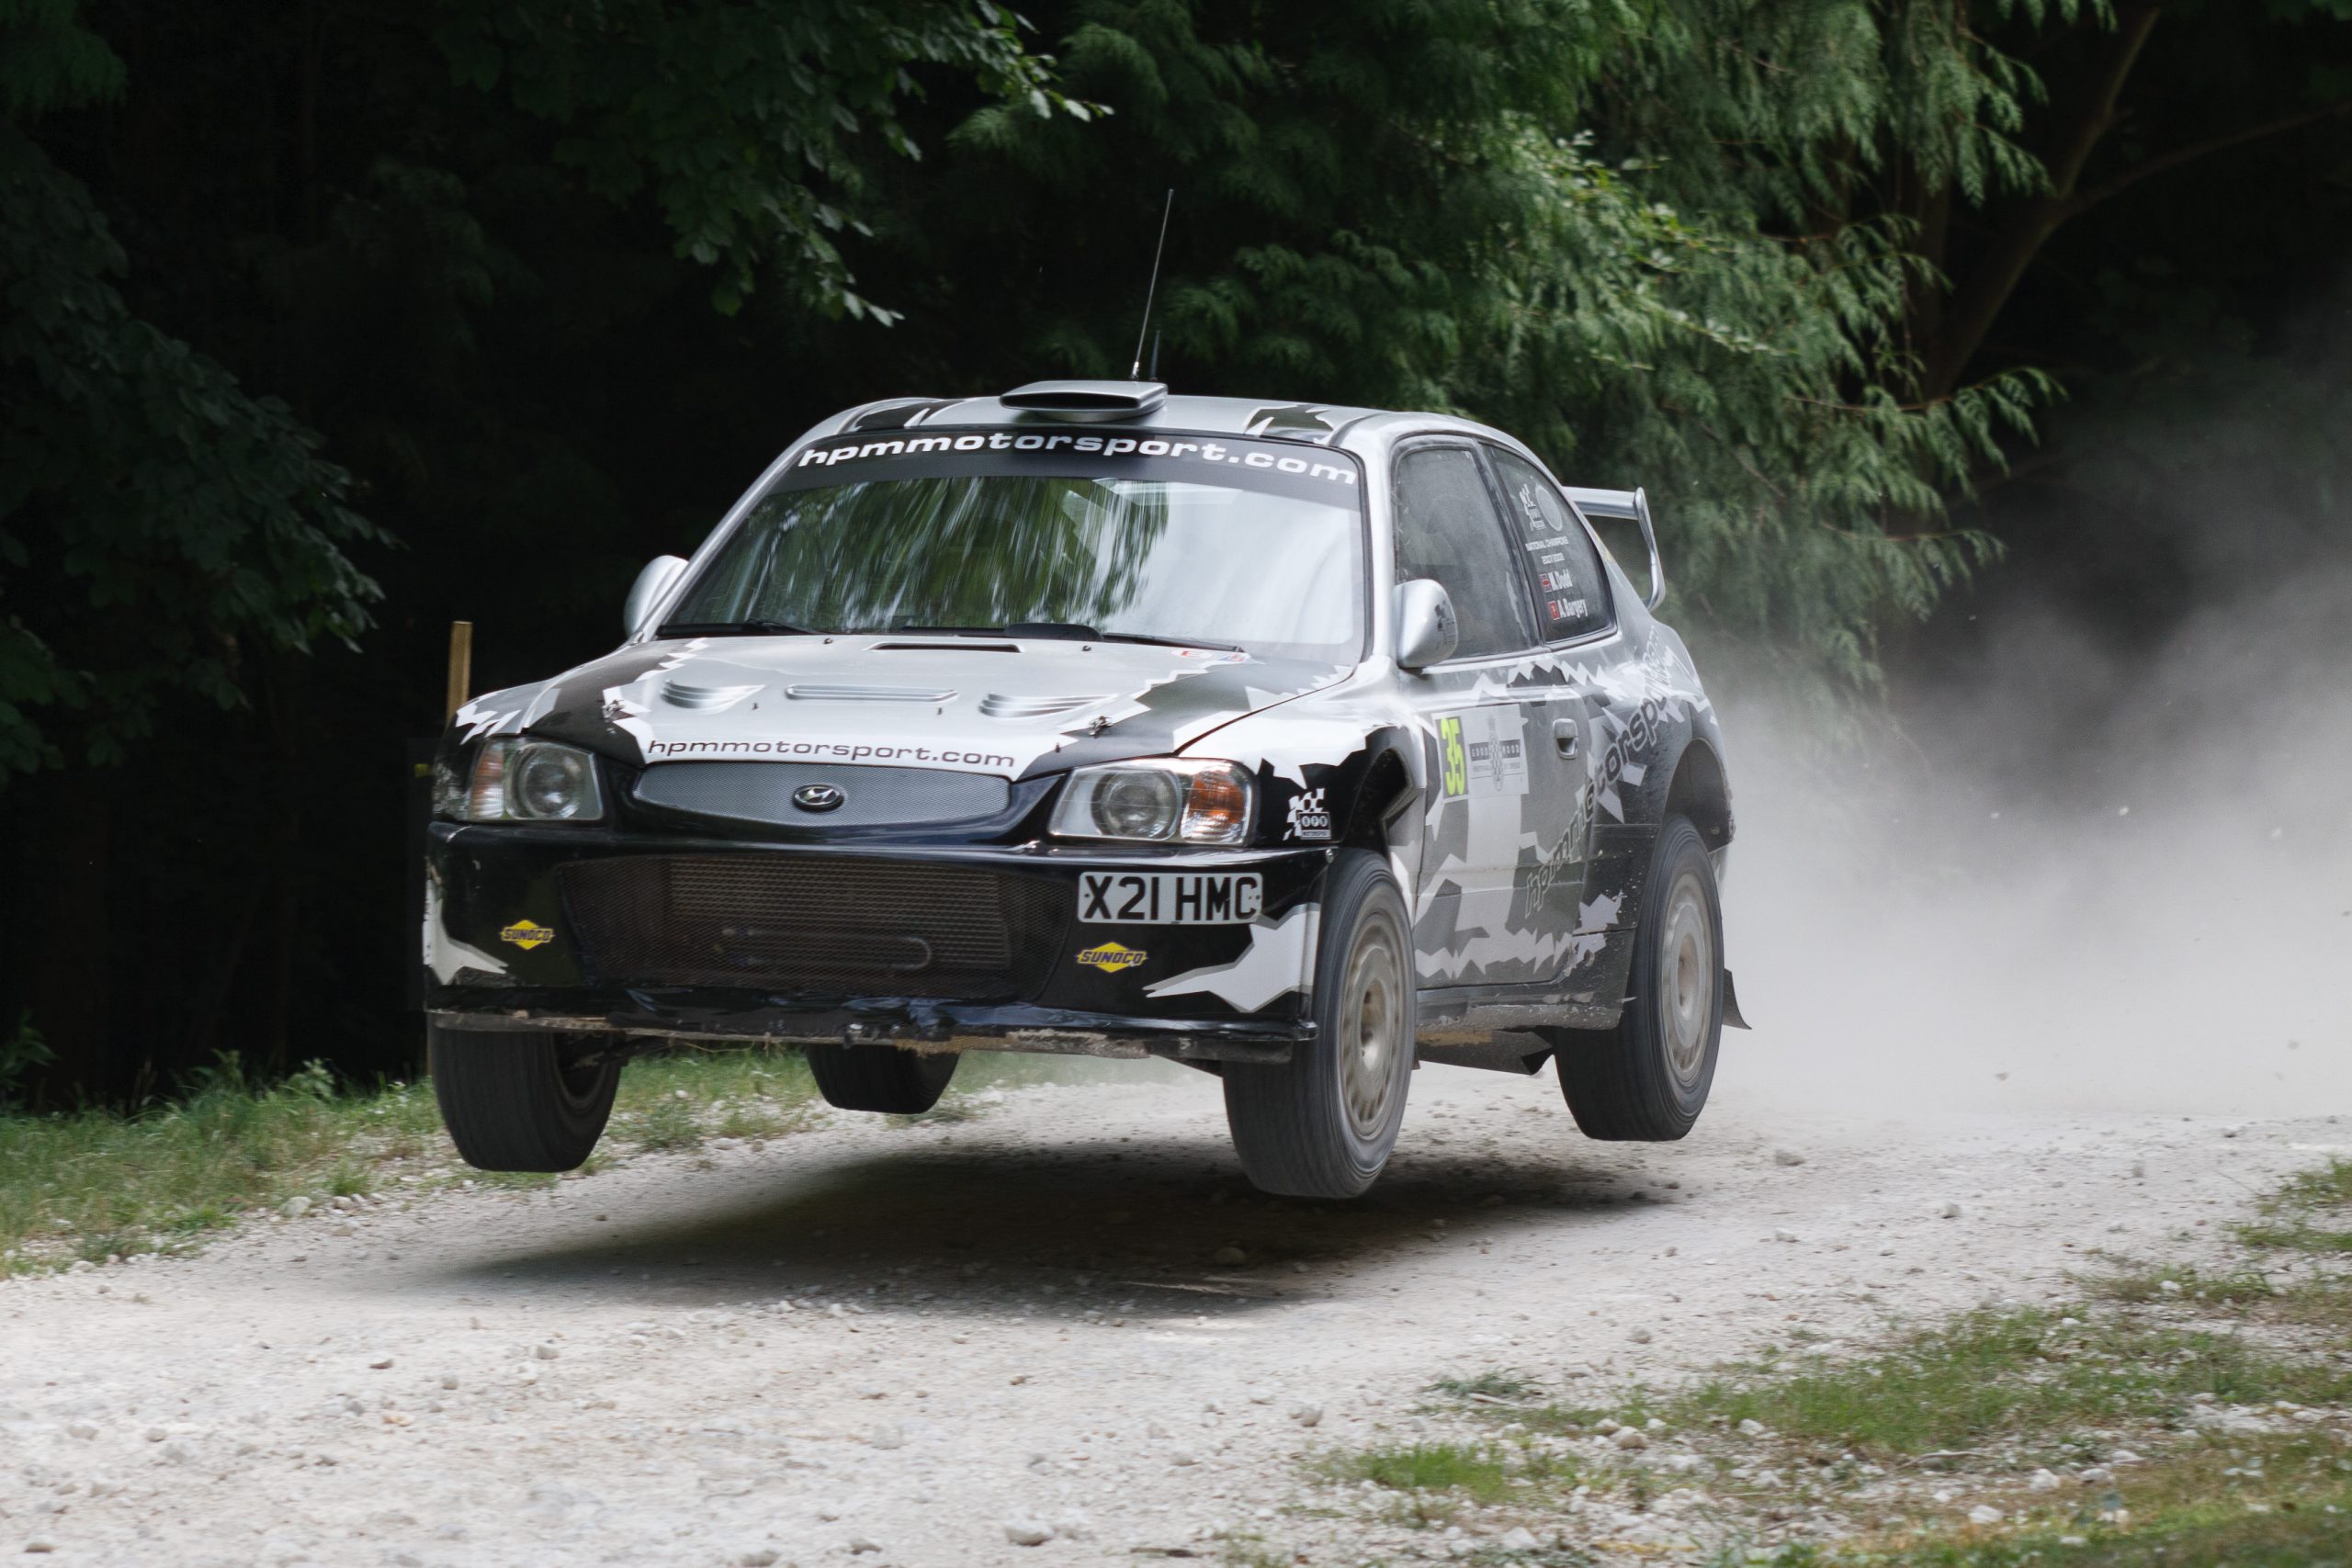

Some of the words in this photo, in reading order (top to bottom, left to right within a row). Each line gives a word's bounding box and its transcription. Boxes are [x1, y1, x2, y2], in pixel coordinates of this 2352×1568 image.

[797, 432, 1357, 485] hpmmotorsport.com
[647, 739, 1015, 768] hpmmotorsport.com
[1441, 716, 1465, 795] 35
[1083, 874, 1159, 920] X21
[1174, 875, 1259, 920] HMC
[504, 929, 550, 941] SUNOCO
[1079, 950, 1145, 964] SUNOCO
